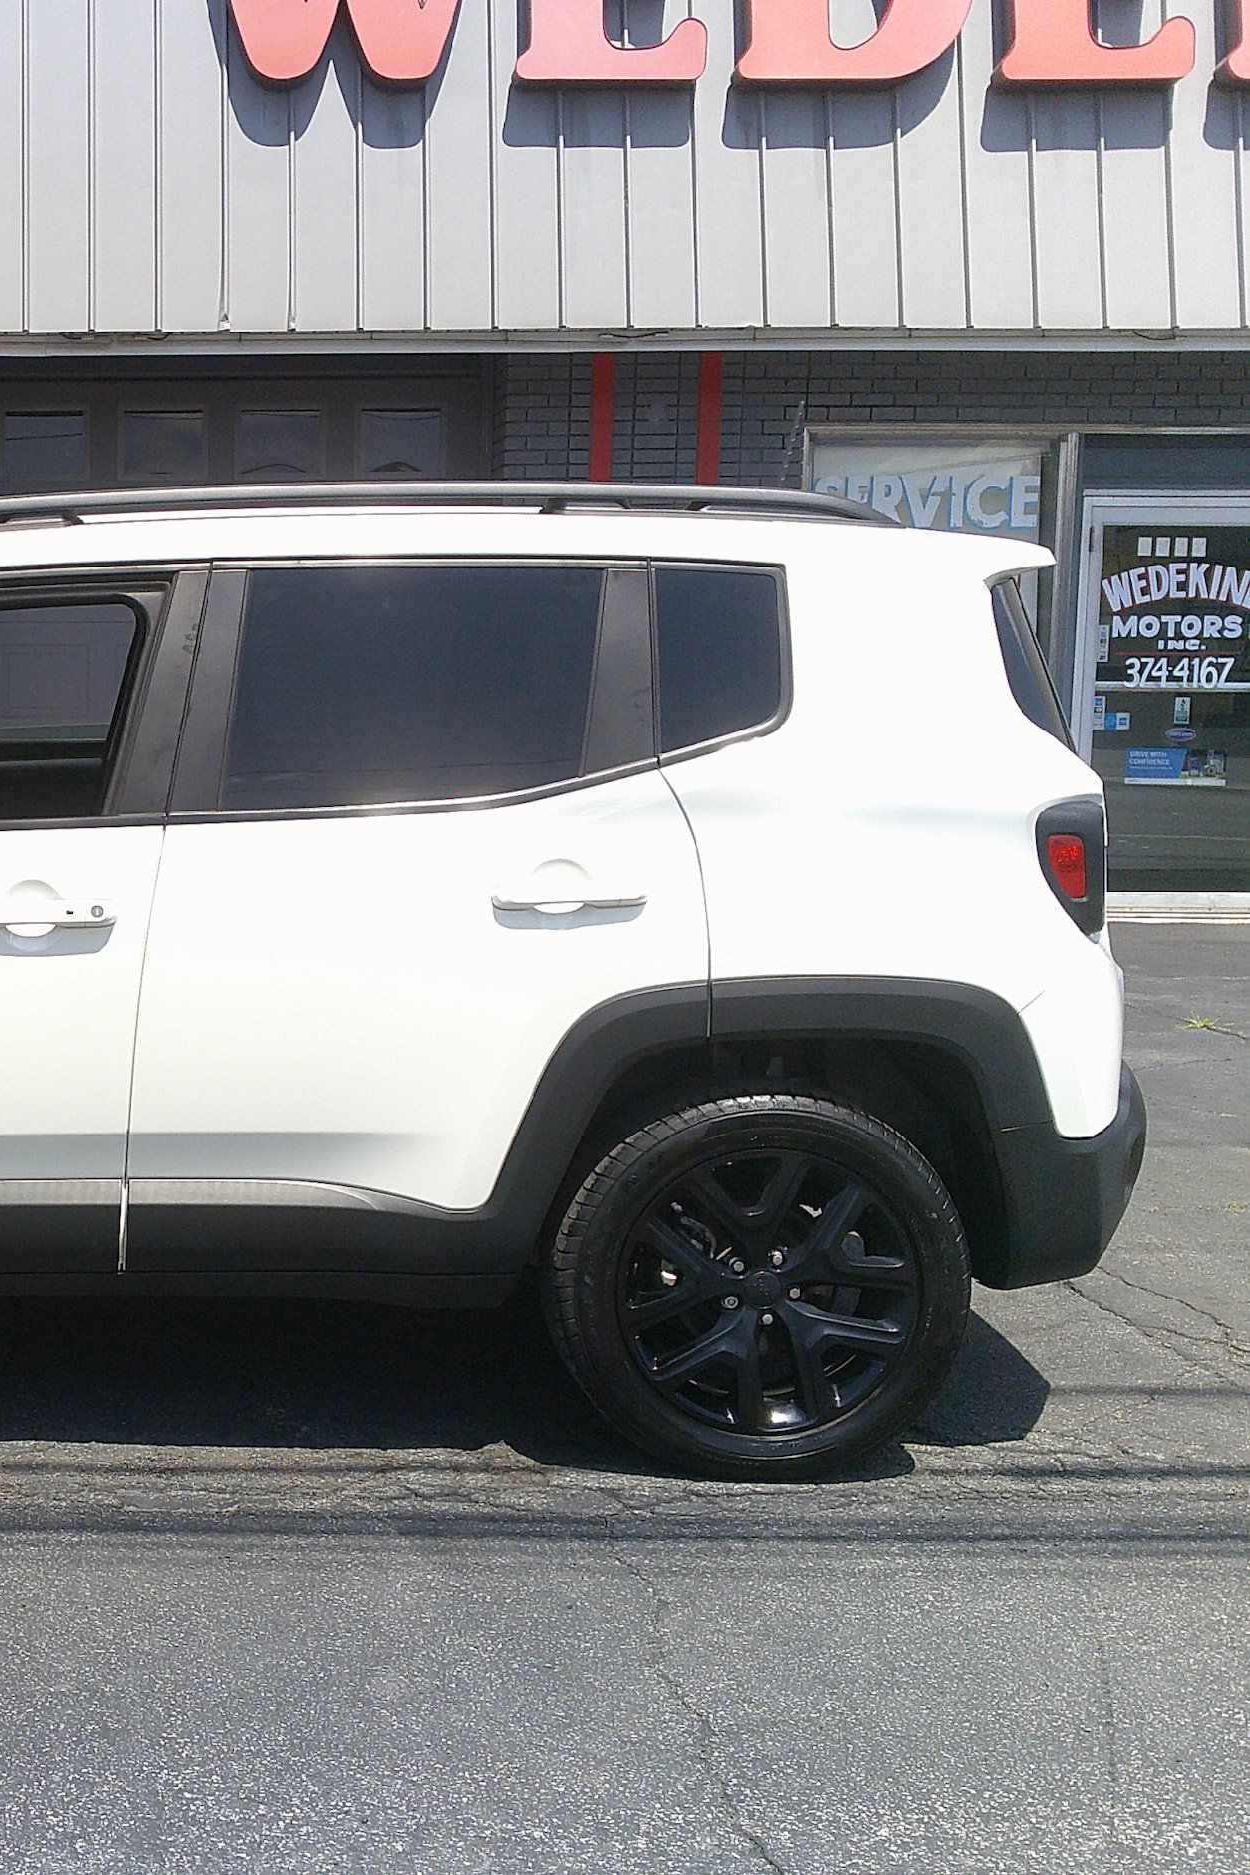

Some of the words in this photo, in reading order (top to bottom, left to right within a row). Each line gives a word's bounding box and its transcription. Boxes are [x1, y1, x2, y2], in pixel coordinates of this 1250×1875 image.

[1111, 615, 1243, 638] MOTORS
[1157, 639, 1206, 650] INC.
[1123, 656, 1235, 689] 374-4167
